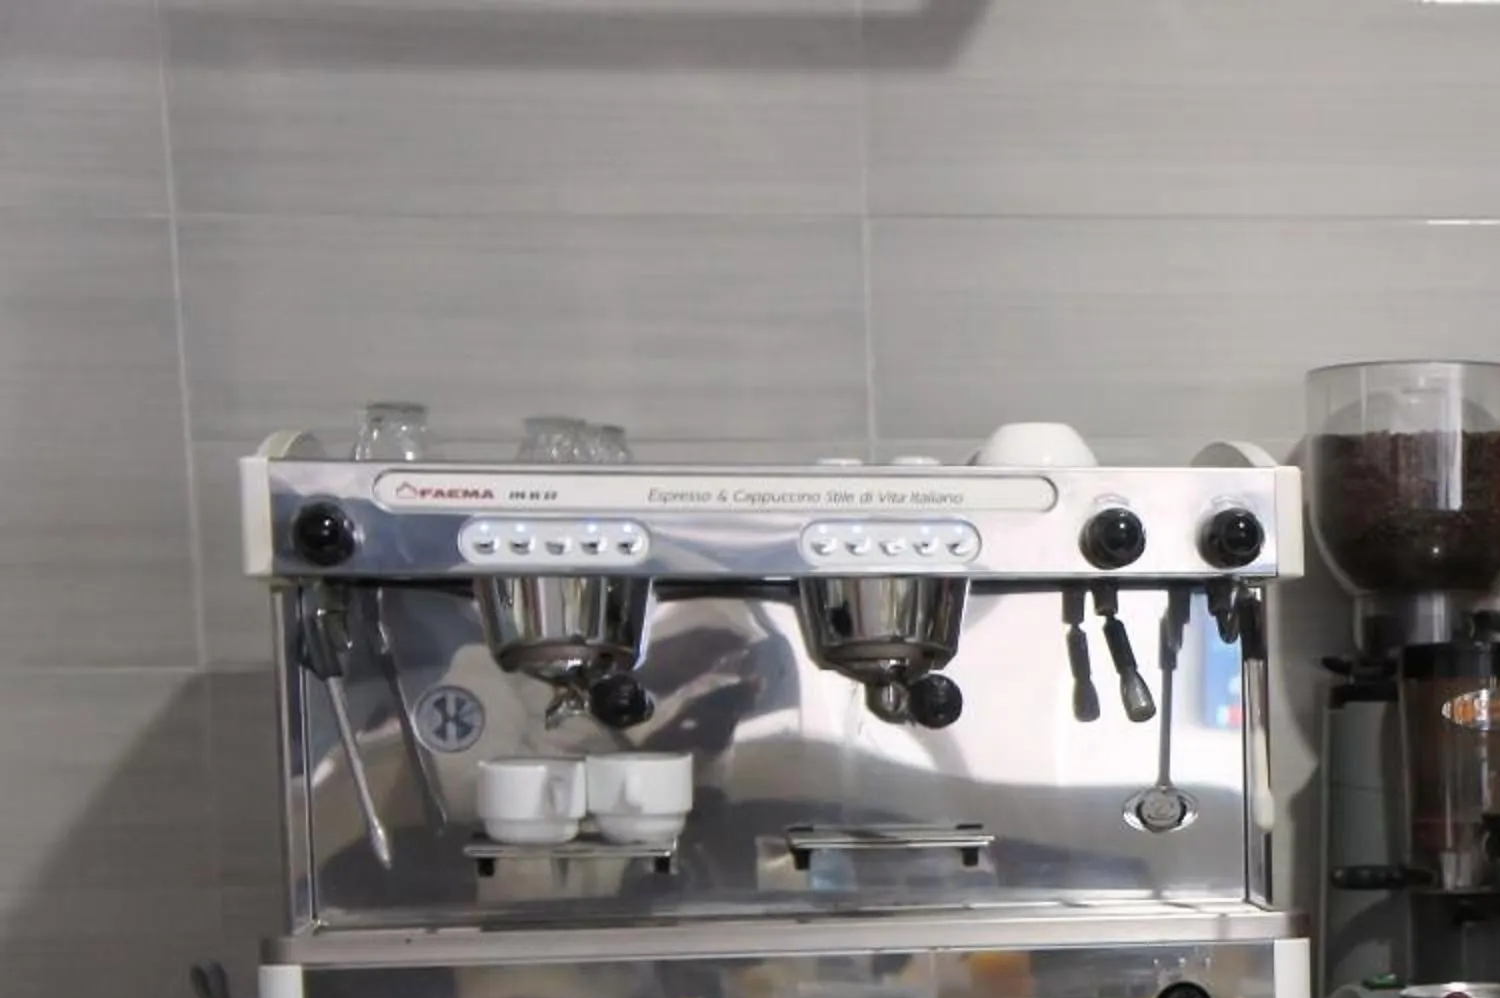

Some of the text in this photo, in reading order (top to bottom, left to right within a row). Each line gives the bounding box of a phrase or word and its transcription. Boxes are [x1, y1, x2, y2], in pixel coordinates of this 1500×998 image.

[418, 487, 494, 499] FAEMA
[647, 488, 712, 504] Espresso
[717, 489, 727, 502] &
[733, 489, 820, 505] Cappuccino
